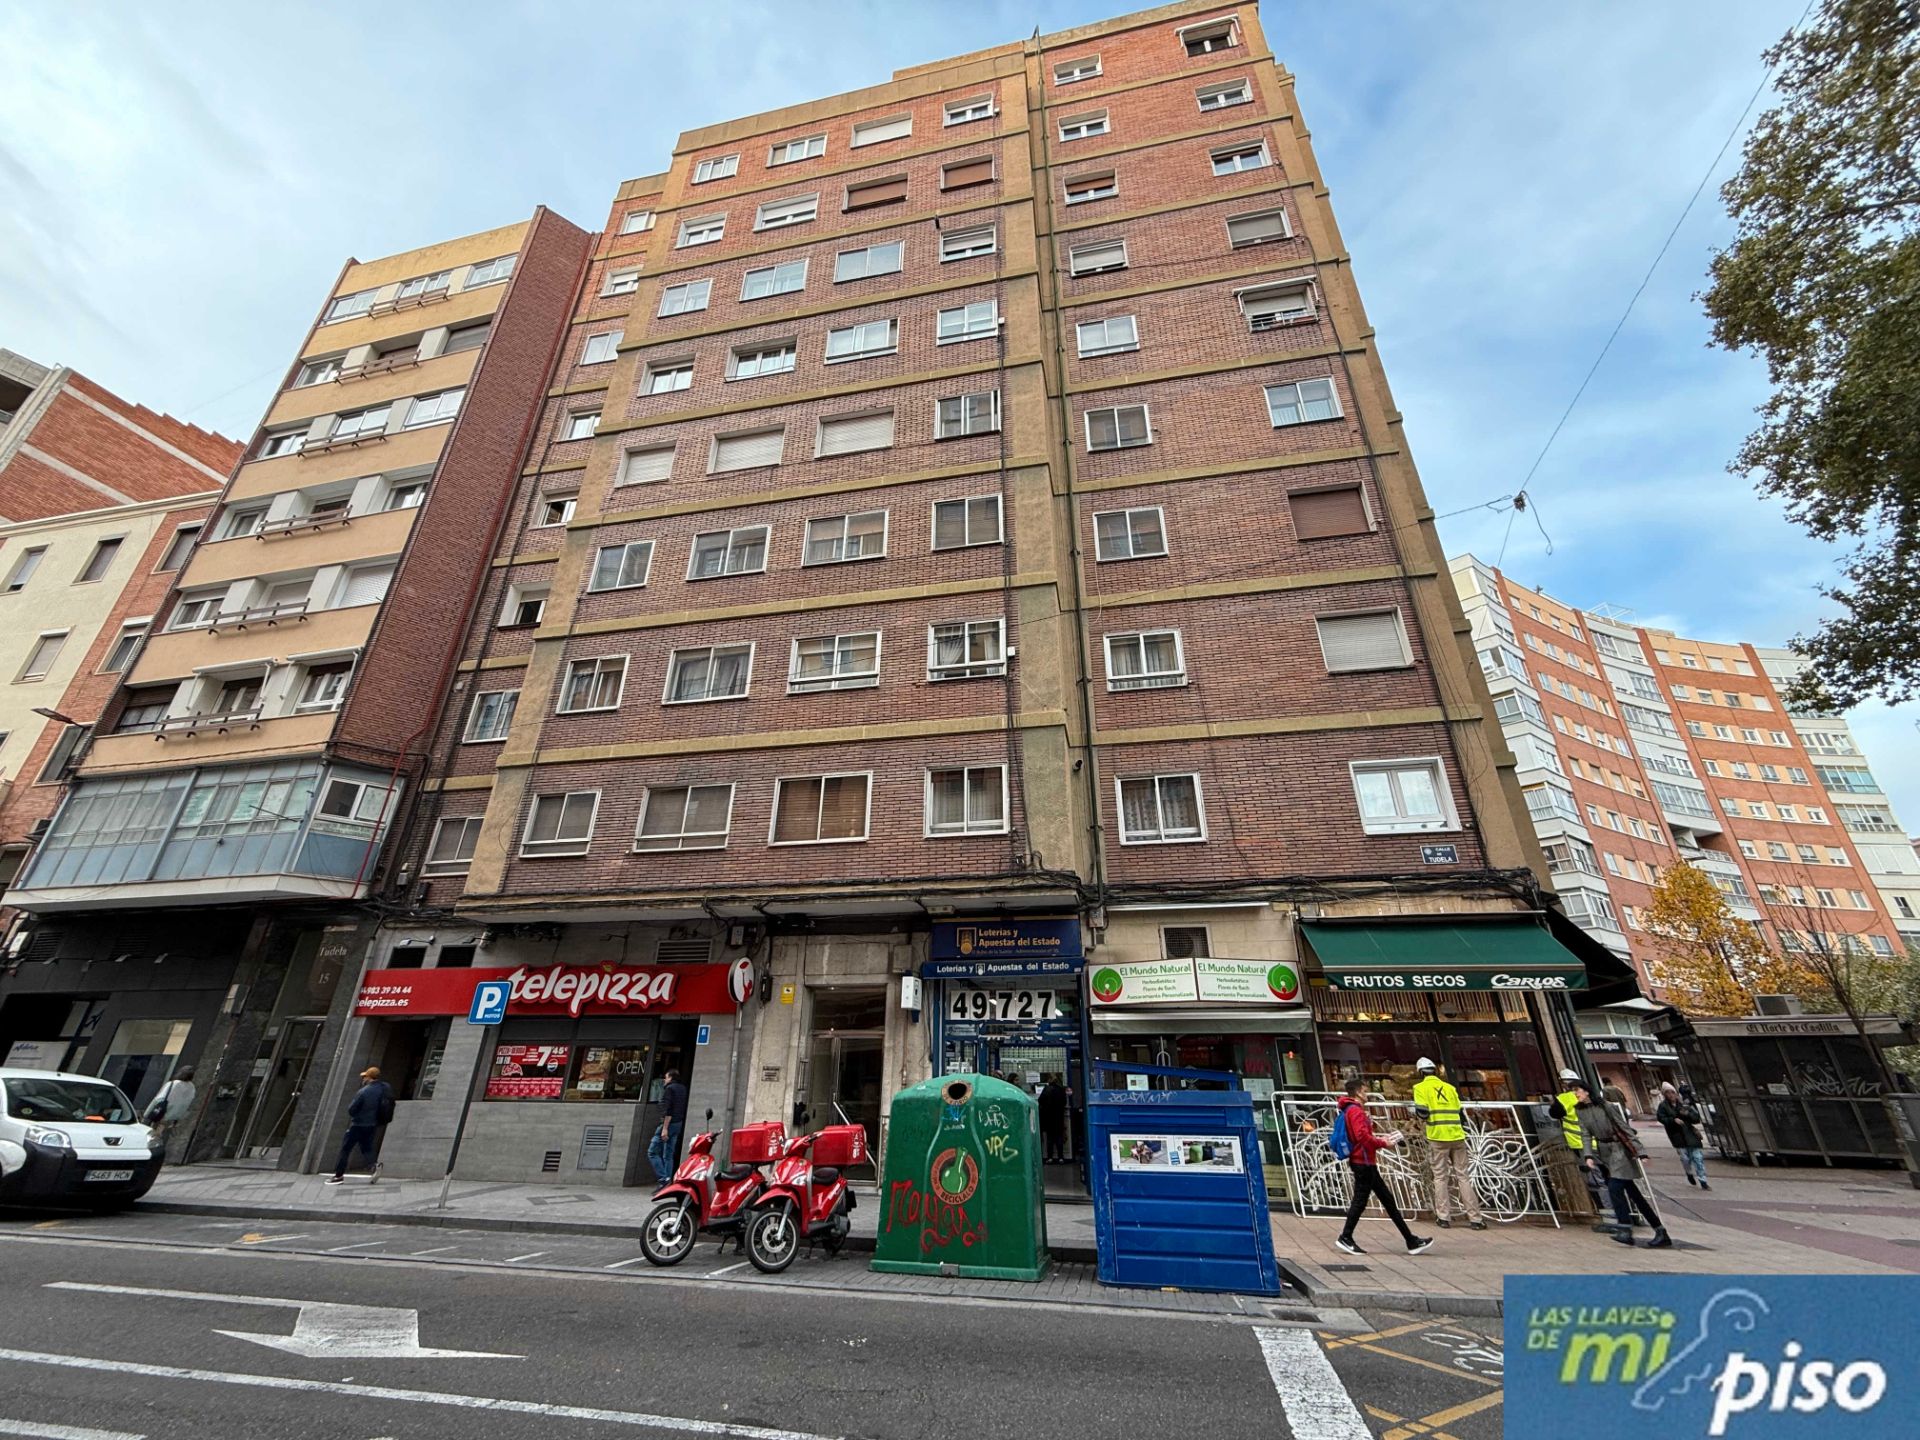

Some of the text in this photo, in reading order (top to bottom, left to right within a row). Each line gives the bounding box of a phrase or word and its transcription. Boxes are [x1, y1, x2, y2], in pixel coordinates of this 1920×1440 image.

[1013, 929, 1018, 938] y
[979, 937, 1061, 948] Apuestas del Estado
[969, 966, 974, 974] y
[987, 962, 1023, 972] Apuestas
[1026, 962, 1039, 970] del
[1042, 961, 1070, 970] Estado
[1120, 963, 1192, 976] El Mundo Natural
[1198, 963, 1266, 973] El Mundo Natural
[318, 972, 331, 984] 15
[1343, 975, 1405, 988] FRUTOS
[1412, 974, 1467, 987] SECOS
[508, 964, 676, 1016] telepizza
[476, 986, 502, 1019] P
[1746, 1023, 1759, 1033] El
[1760, 1023, 1787, 1033] Norte
[1800, 1021, 1841, 1033] Castilla
[616, 1060, 645, 1075] OPEN
